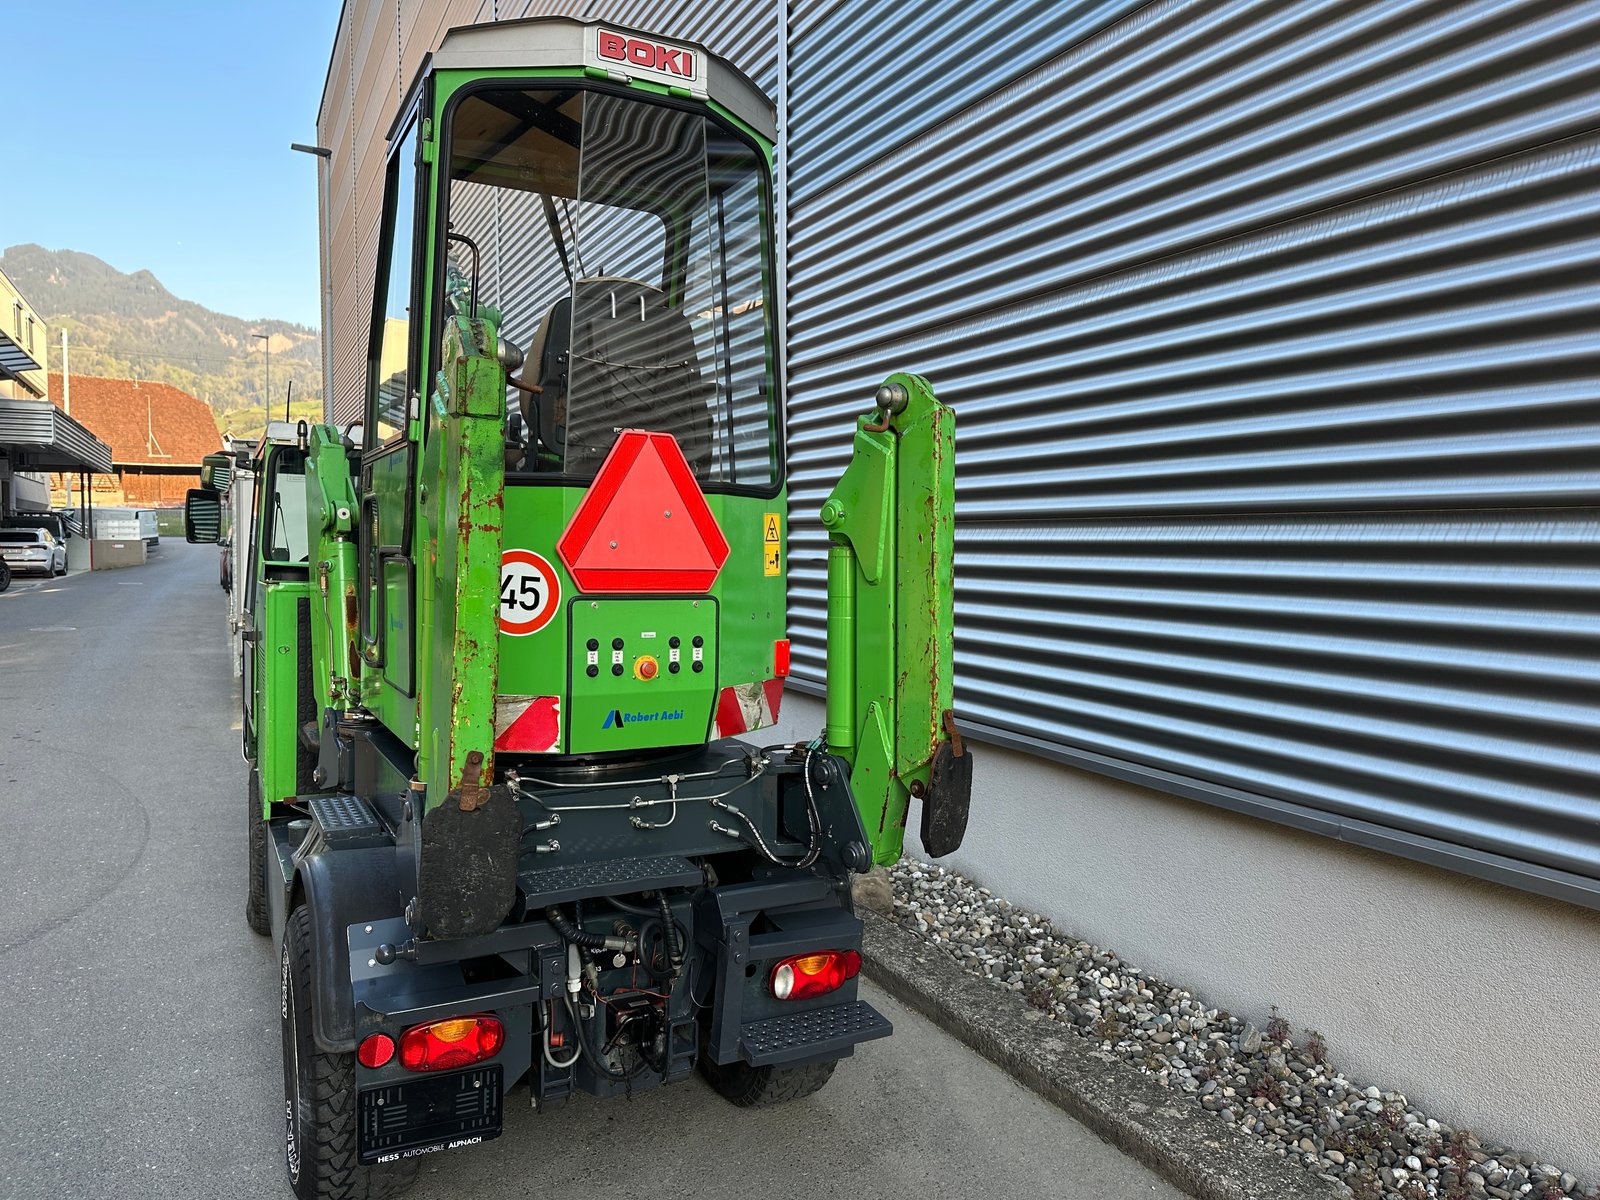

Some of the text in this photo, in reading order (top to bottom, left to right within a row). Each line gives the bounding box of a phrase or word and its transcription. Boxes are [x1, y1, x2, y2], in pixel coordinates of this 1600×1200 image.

[599, 31, 693, 78] BOKI
[501, 574, 541, 611] 45
[624, 709, 684, 722] Robert Aebi
[377, 1136, 482, 1164] HESS AUTOMOBILE ALPNACH
